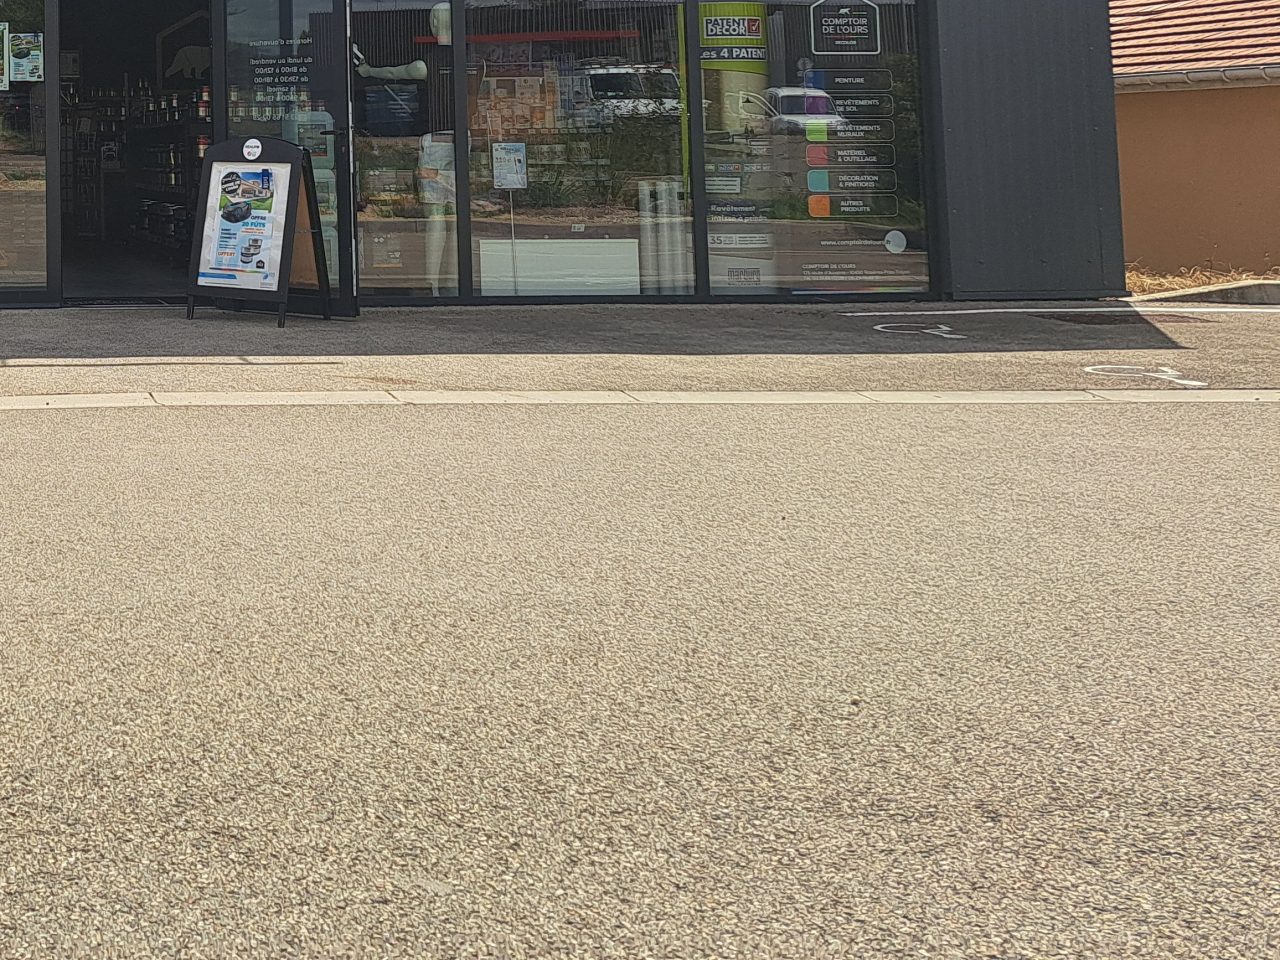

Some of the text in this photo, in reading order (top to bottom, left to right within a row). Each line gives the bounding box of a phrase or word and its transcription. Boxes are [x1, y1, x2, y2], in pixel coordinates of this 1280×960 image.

[706, 18, 745, 27] PATENT
[822, 17, 867, 25] COMPTOIR
[708, 26, 745, 35] DECOR
[822, 25, 869, 33] DE L'OURS
[720, 48, 729, 58] 4
[710, 236, 723, 244] 35
